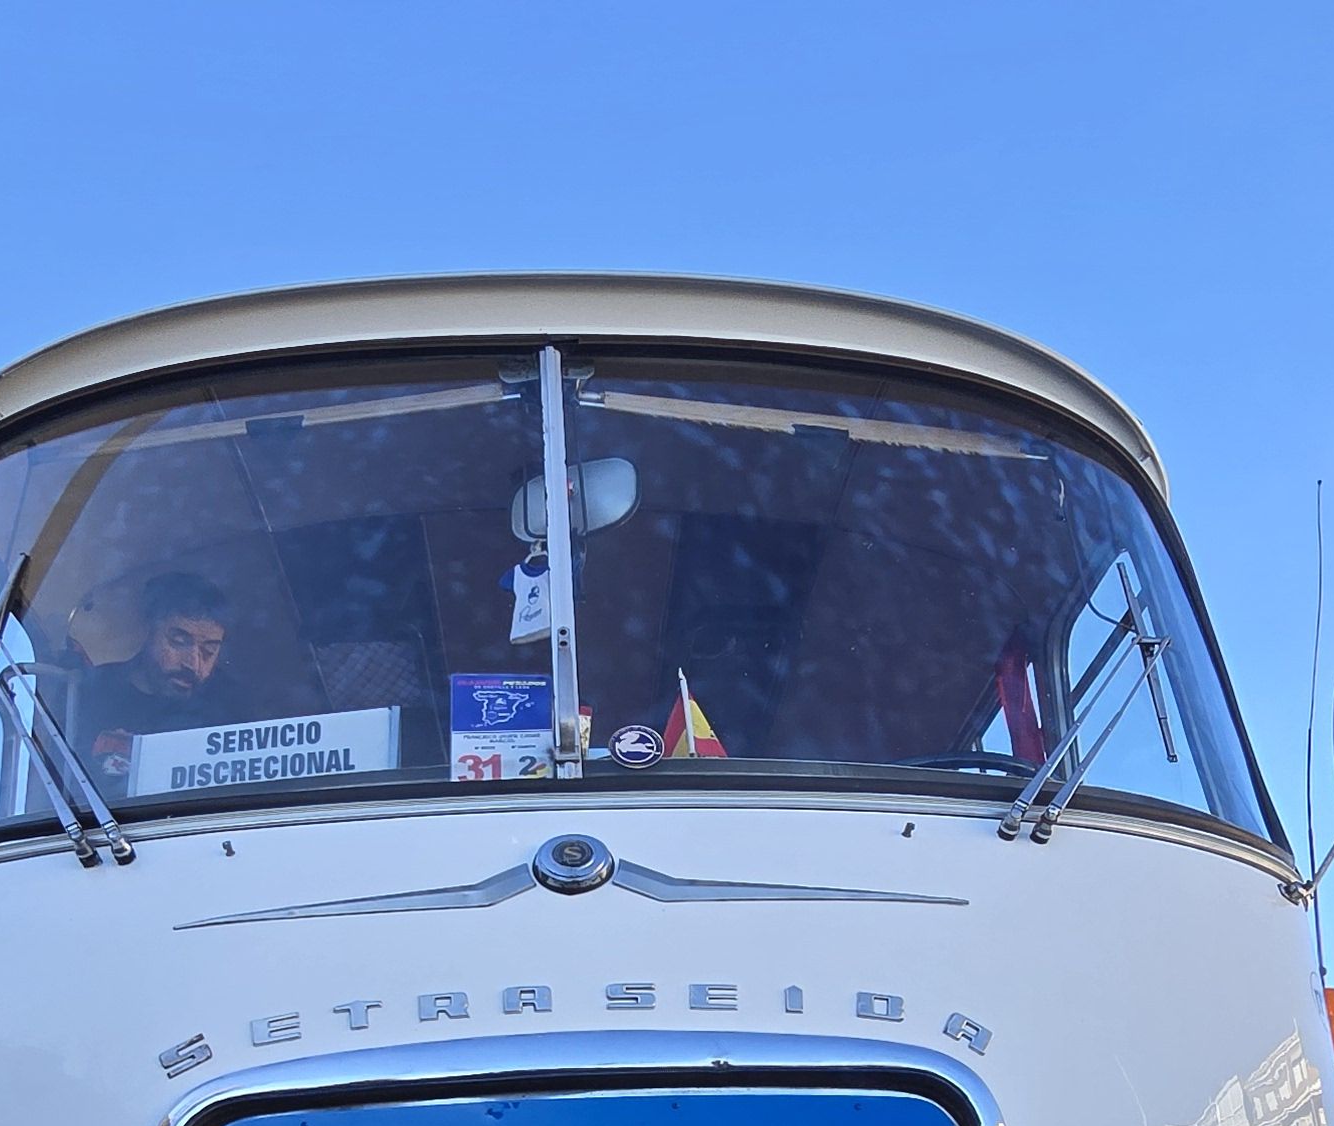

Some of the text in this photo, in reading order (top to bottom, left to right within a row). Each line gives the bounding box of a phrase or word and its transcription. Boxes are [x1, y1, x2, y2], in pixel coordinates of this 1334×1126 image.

[206, 721, 322, 755] SERVICIO
[170, 748, 355, 789] DISCRECIONAL
[458, 754, 501, 781] 31
